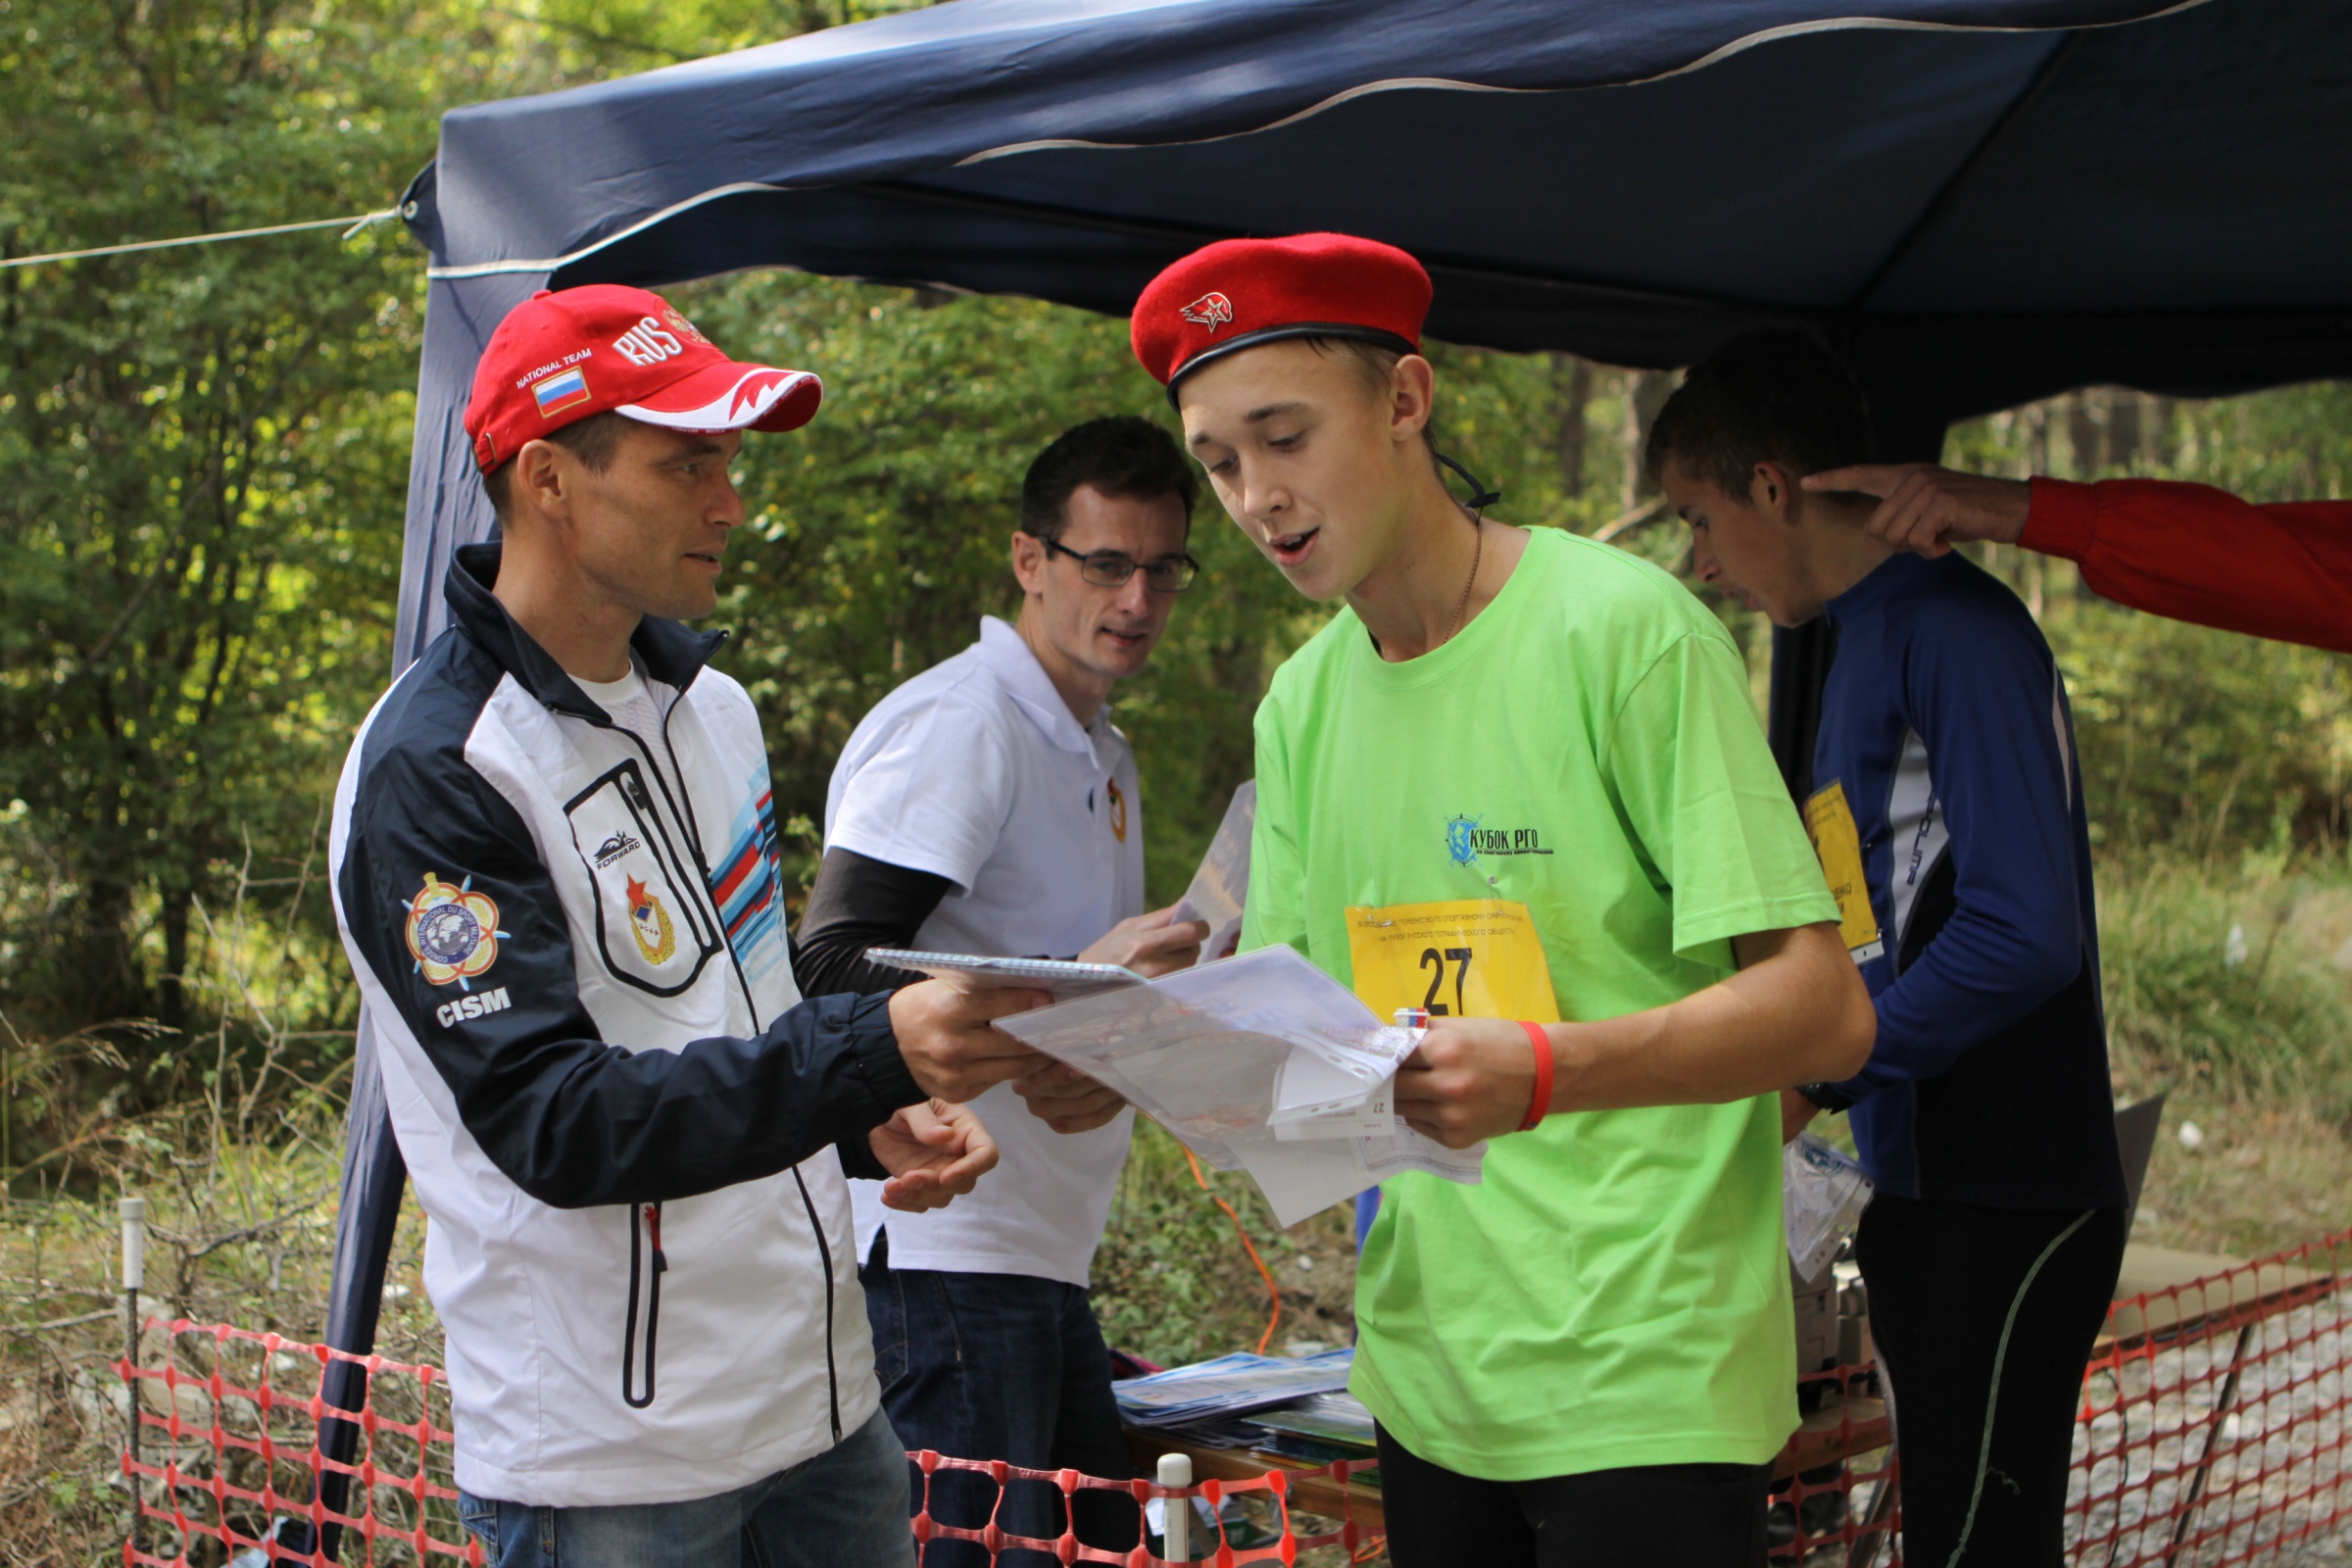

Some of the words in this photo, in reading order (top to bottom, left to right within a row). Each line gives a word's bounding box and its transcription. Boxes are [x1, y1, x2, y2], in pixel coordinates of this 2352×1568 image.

[612, 317, 683, 367] RUS
[515, 360, 563, 389] NATIONAL
[563, 348, 592, 366] TEAM
[597, 841, 641, 870] FORWARD
[1471, 829, 1509, 849] КУБОК
[1514, 829, 1539, 848] РГО
[458, 907, 476, 926] SPORT
[1419, 948, 1473, 1016] 27
[436, 987, 512, 1028] CISM
[1373, 1102, 1385, 1113] 27
